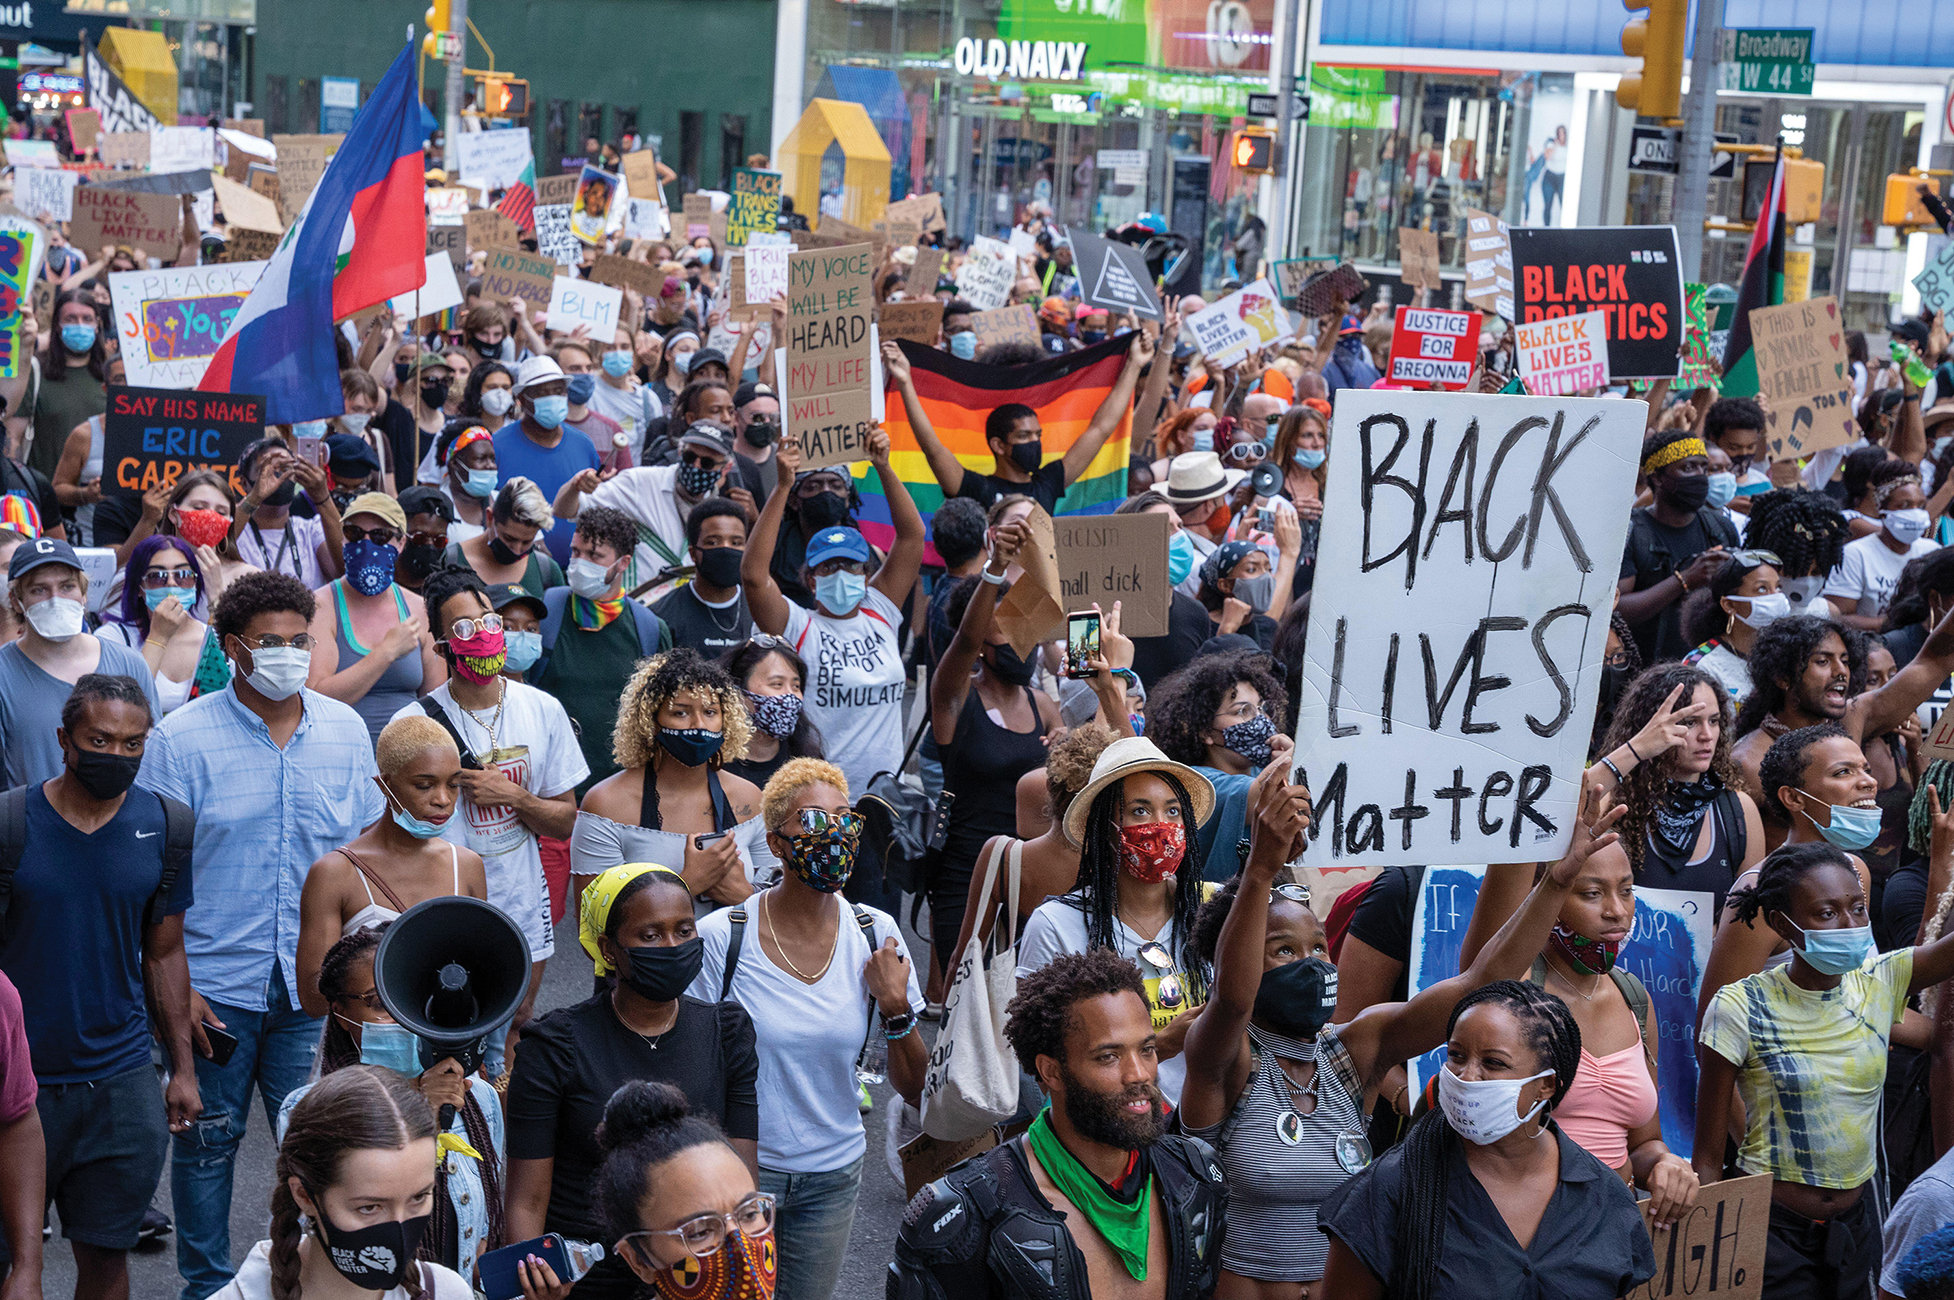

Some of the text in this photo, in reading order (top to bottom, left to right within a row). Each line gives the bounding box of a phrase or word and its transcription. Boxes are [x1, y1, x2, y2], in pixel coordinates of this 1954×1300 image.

[955, 37, 1087, 80] OLD NAVY
[1739, 31, 1809, 64] Broadway
[1744, 62, 1813, 91] W 44 St
[736, 172, 781, 193] BLACK
[79, 190, 140, 211] BLACK
[733, 190, 780, 212] TRANS
[729, 208, 778, 228] LIVES
[492, 252, 516, 272] NO
[791, 253, 869, 288] MY VOICE
[144, 269, 250, 300] BLACK
[484, 274, 514, 297] NO
[1522, 264, 1630, 303] BLACK
[561, 289, 611, 326] BLM
[792, 286, 861, 317] WILL BE
[792, 315, 866, 353] HEARD
[972, 310, 1024, 335] BLACK
[1196, 312, 1227, 333] BLACK
[1201, 324, 1230, 344] LIVES
[1407, 312, 1468, 333] JUSTICE
[1518, 318, 1588, 350] BLACK
[1765, 305, 1816, 335] THIS IS
[1206, 328, 1248, 355] MATTER
[1421, 338, 1453, 355] FOR
[1530, 341, 1592, 371] LIVES
[791, 357, 864, 393] MY LIFE
[1393, 360, 1468, 380] BREONNA
[1524, 362, 1606, 396] MATTER
[114, 394, 258, 423] SAY HIS NAME
[792, 398, 835, 421] WILL
[1812, 395, 1837, 410] TOO
[142, 426, 221, 459] ERIC
[792, 421, 865, 461] MATTER
[36, 540, 56, 554] C
[1102, 564, 1142, 593] dick
[818, 667, 844, 687] BE
[1327, 602, 1592, 739] LIVES
[1429, 884, 1461, 933] If
[1641, 957, 1693, 997] Hard
[933, 1203, 963, 1233] FOX
[331, 1246, 356, 1258] BLACK
[333, 1256, 356, 1266] LIVES
[337, 1263, 368, 1274] MATTER
